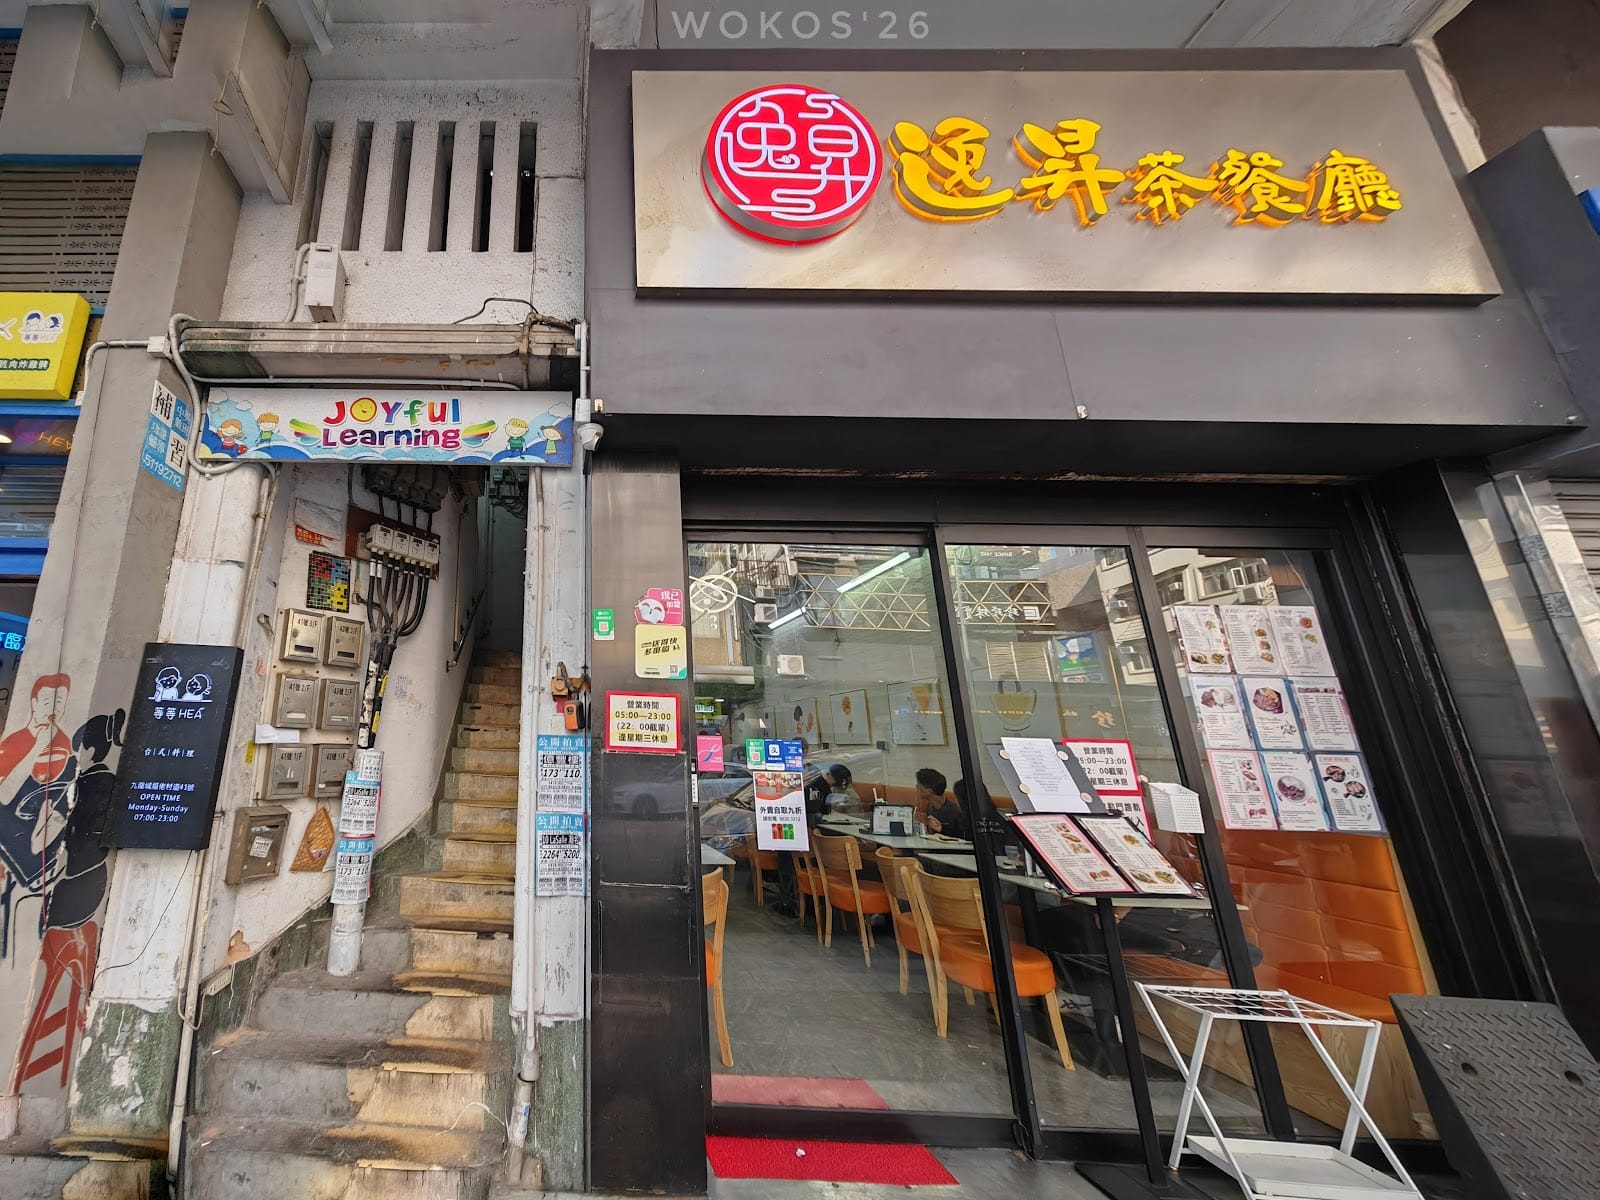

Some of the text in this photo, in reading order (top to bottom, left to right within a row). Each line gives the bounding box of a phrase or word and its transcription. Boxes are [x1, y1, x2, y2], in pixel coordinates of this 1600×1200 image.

[898, 117, 1402, 214] 逸昇茶餐廳
[322, 428, 461, 449] Learning
[627, 700, 659, 710] 營業時間
[153, 706, 205, 720] 等等 HEA
[140, 793, 181, 802] OPEN TIME
[128, 803, 189, 814] Monday-Sunday
[760, 806, 802, 815] 外賣自取九折
[134, 814, 179, 822] 07:00-23:00
